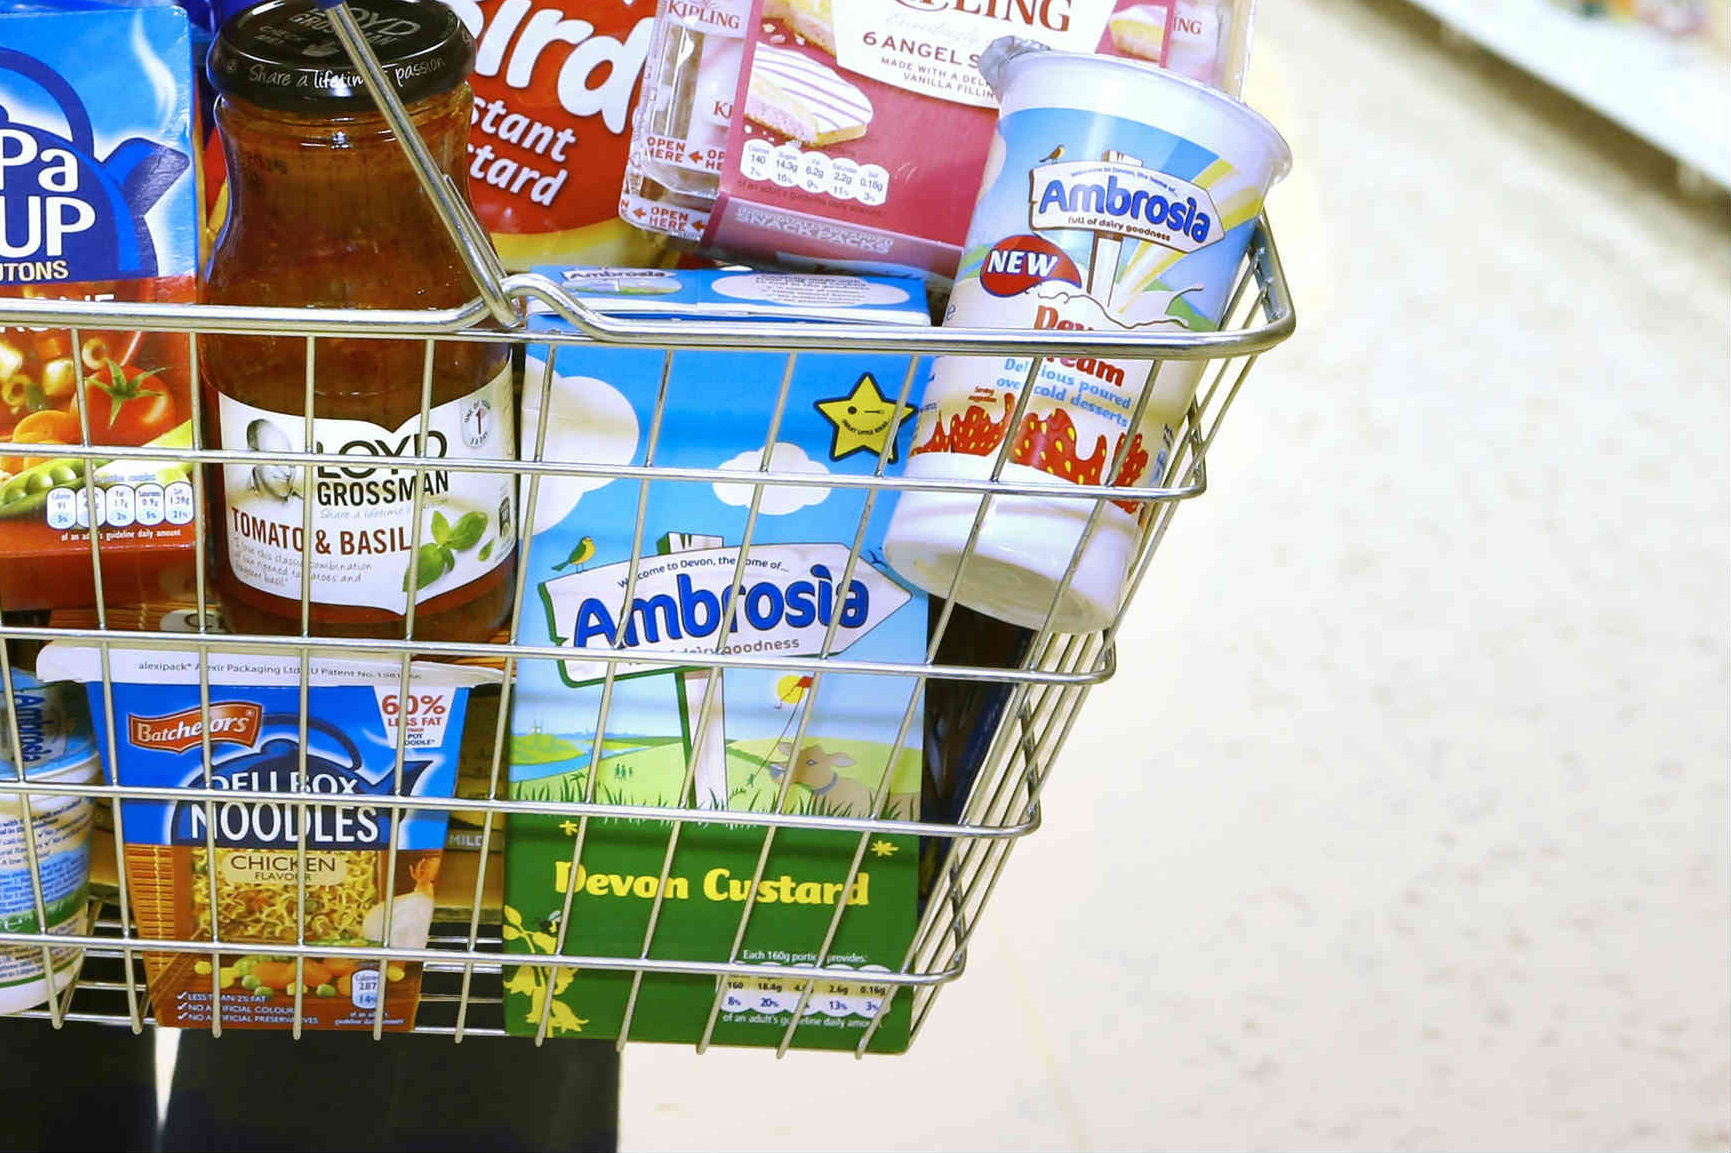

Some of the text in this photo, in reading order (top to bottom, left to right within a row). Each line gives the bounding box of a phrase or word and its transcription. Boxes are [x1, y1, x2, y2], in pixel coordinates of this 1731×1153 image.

[862, 31, 878, 47] 6
[881, 34, 963, 67] ANGEL
[248, 63, 292, 88] Share
[394, 56, 447, 88] passion
[880, 56, 959, 81] MADE WITH A
[903, 72, 995, 100] VANILLA FILLIN
[470, 95, 577, 163] stant
[645, 148, 684, 164] HERE
[647, 135, 687, 153] OPEN
[468, 144, 569, 206] tard
[650, 205, 690, 222] OPEN
[1039, 174, 1211, 244] Ambrosia
[648, 215, 688, 233] HERE
[1086, 216, 1099, 226] of
[1098, 218, 1125, 231] dairy
[1125, 223, 1171, 242] goodness
[986, 249, 1061, 278] NEW
[1003, 357, 1133, 410] Delious poured
[996, 376, 1129, 429] ove cold desserts
[317, 469, 451, 508] GROSSMAN
[231, 506, 413, 556] TOMATO & BASIL
[666, 560, 678, 572] to
[680, 556, 717, 569] Devon,
[718, 555, 736, 566] the
[744, 557, 768, 567] ome
[572, 562, 871, 651] Ambrosia
[722, 636, 801, 657] goodness
[227, 663, 281, 677] Packaging
[380, 694, 447, 716] 60%
[136, 715, 251, 744] Batcheors
[387, 715, 442, 728] LESS FAT
[190, 800, 380, 844] NOODLES
[230, 855, 336, 872] CHICKEN
[254, 871, 312, 882] FLAVOR
[554, 860, 871, 908] Devon Custard
[742, 949, 766, 961] Each
